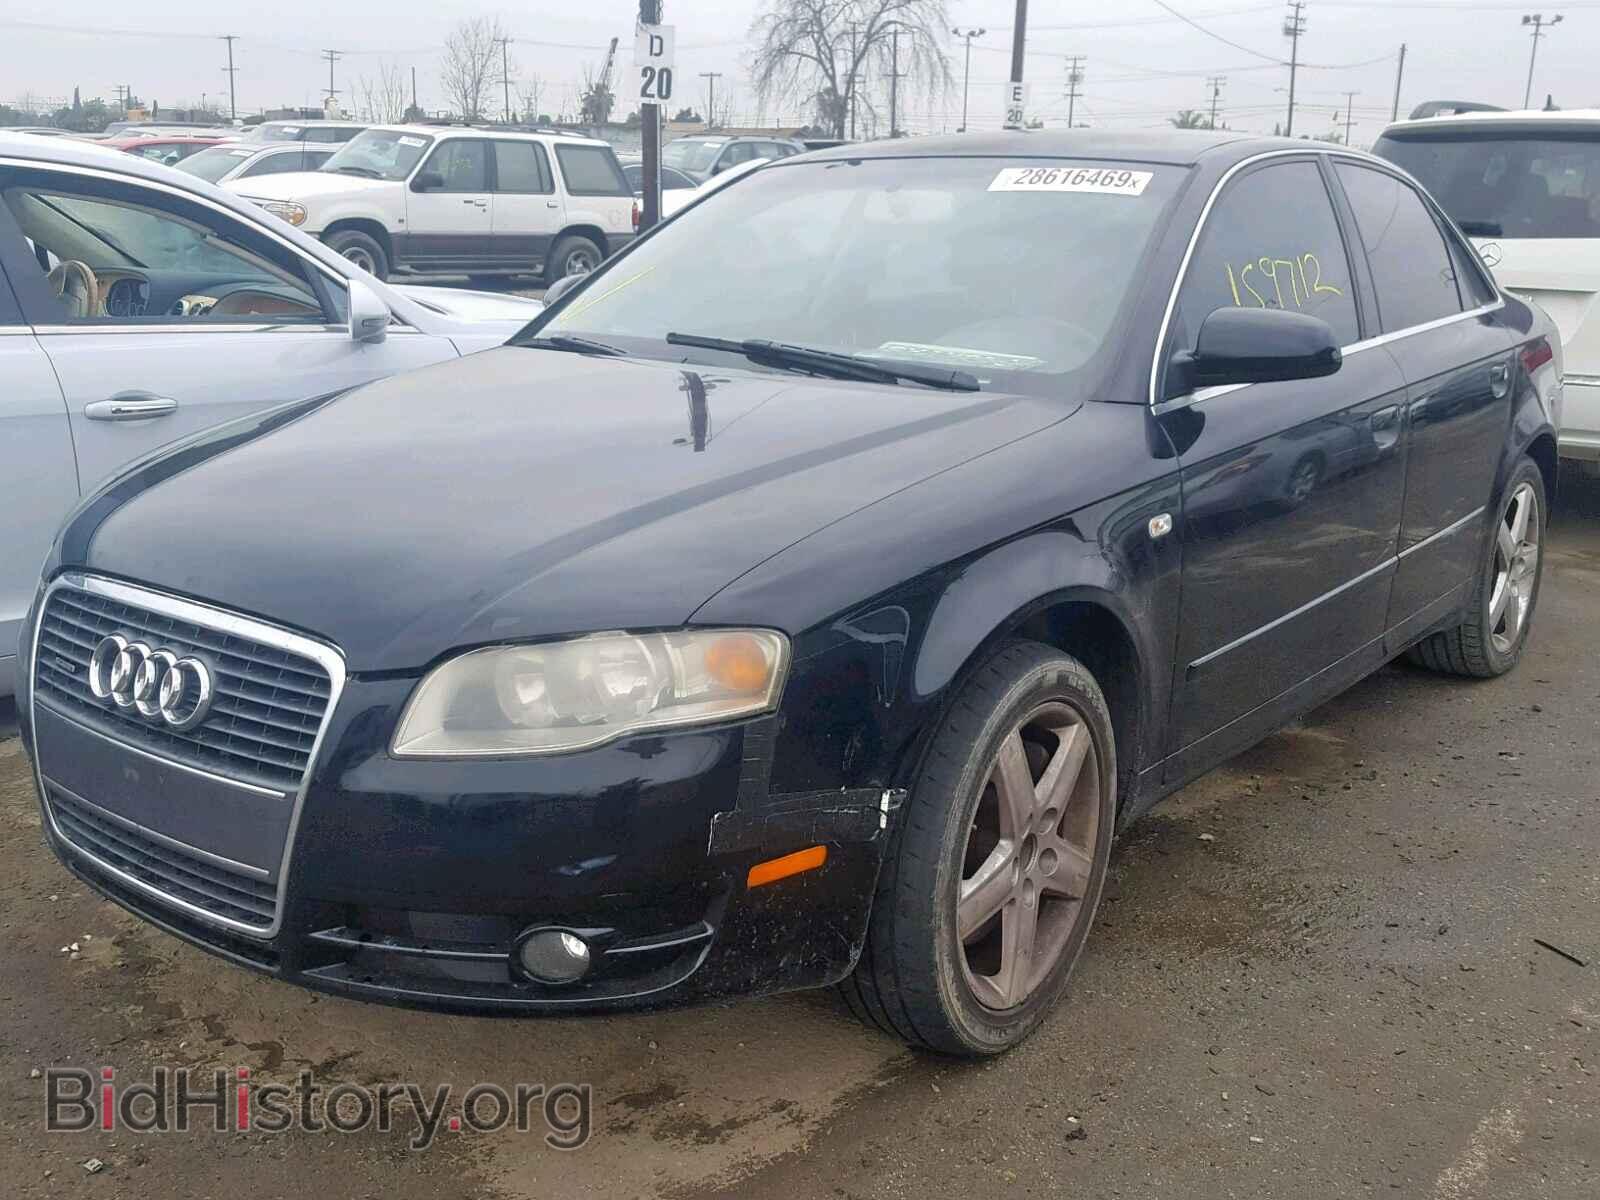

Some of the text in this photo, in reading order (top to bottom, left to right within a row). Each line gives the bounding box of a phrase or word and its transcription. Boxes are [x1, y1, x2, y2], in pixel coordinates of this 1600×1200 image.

[649, 34, 664, 57] D
[640, 66, 672, 100] 20
[1013, 86, 1022, 101] E
[1007, 109, 1023, 121] 20
